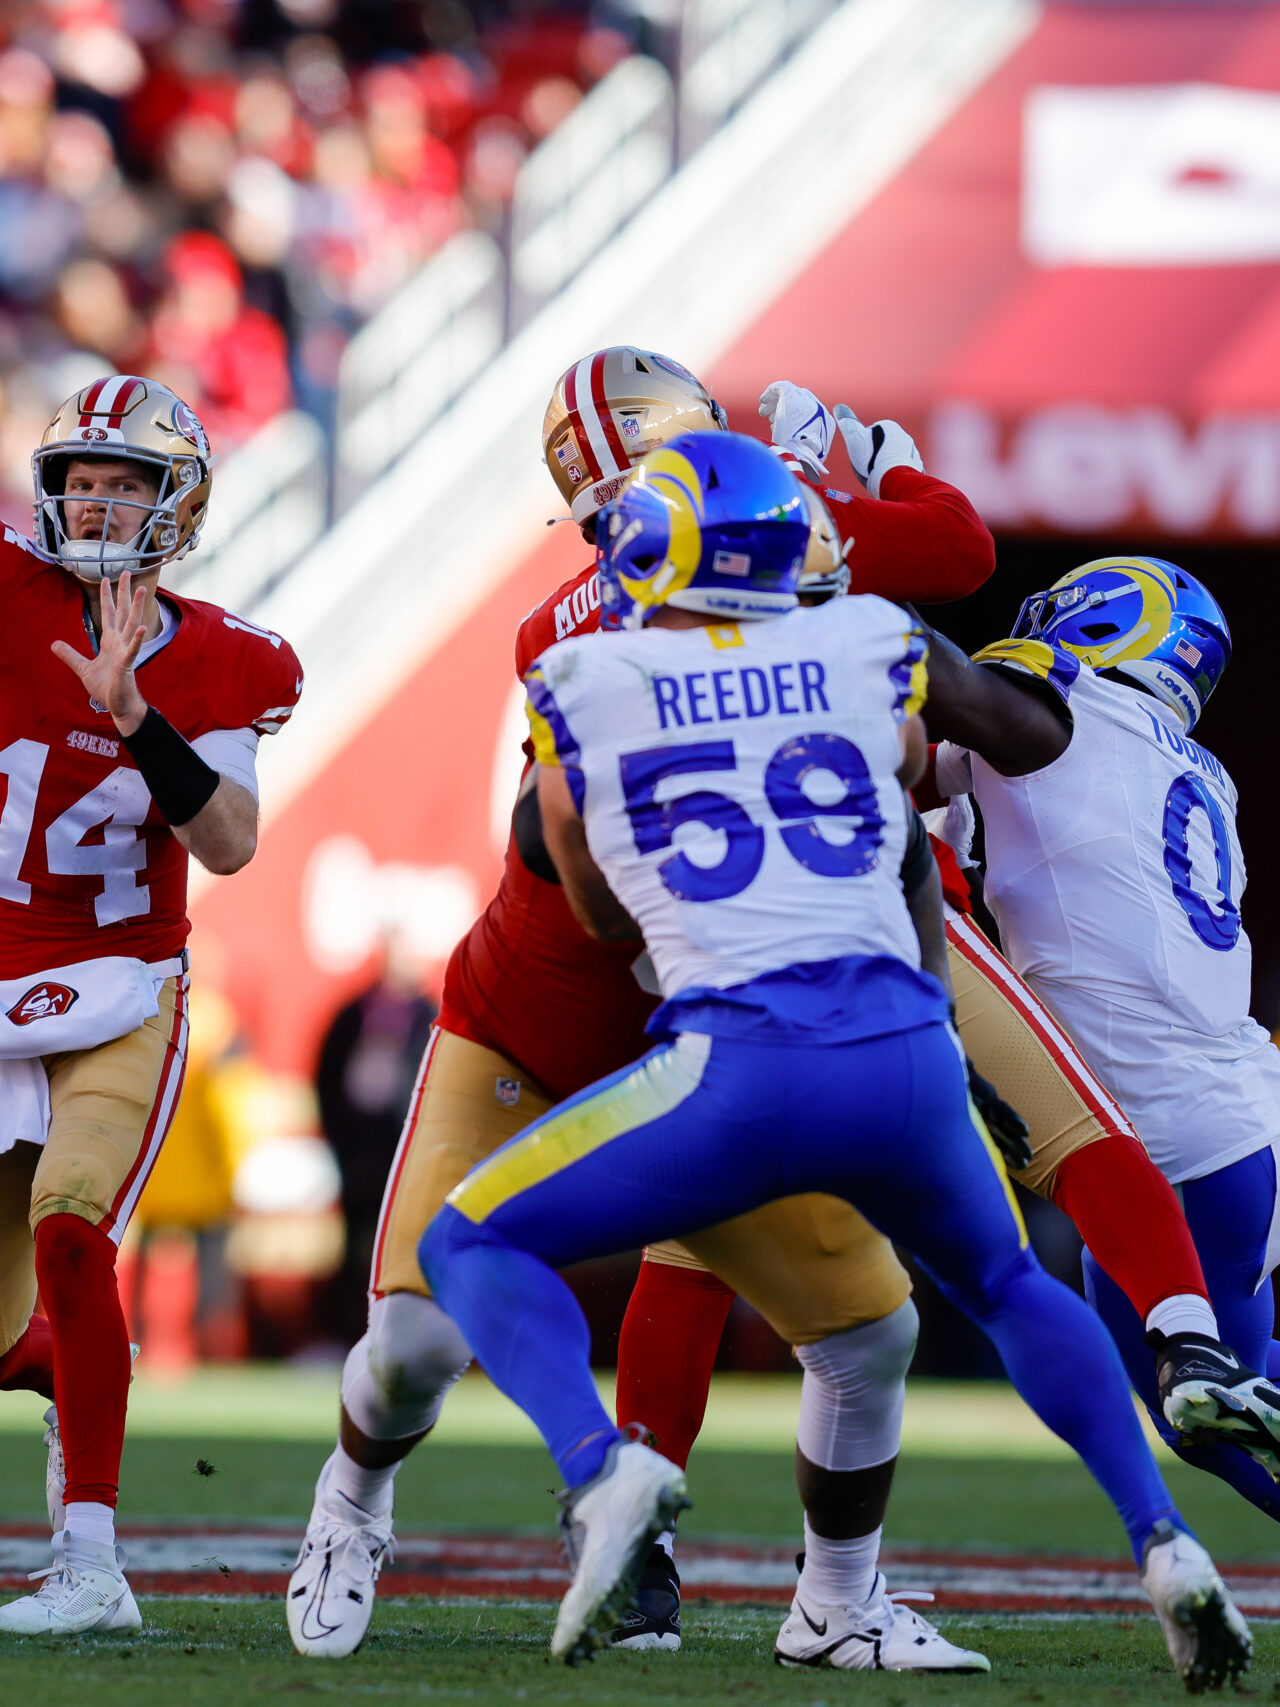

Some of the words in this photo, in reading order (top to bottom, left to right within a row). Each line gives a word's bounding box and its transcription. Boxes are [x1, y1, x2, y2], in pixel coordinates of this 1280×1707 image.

[569, 467, 581, 481] 64
[652, 661, 830, 729] REEDER
[1156, 671, 1183, 695] LOS
[66, 729, 120, 758] 49ERS
[619, 733, 886, 903] 59
[1162, 771, 1241, 951] 0
